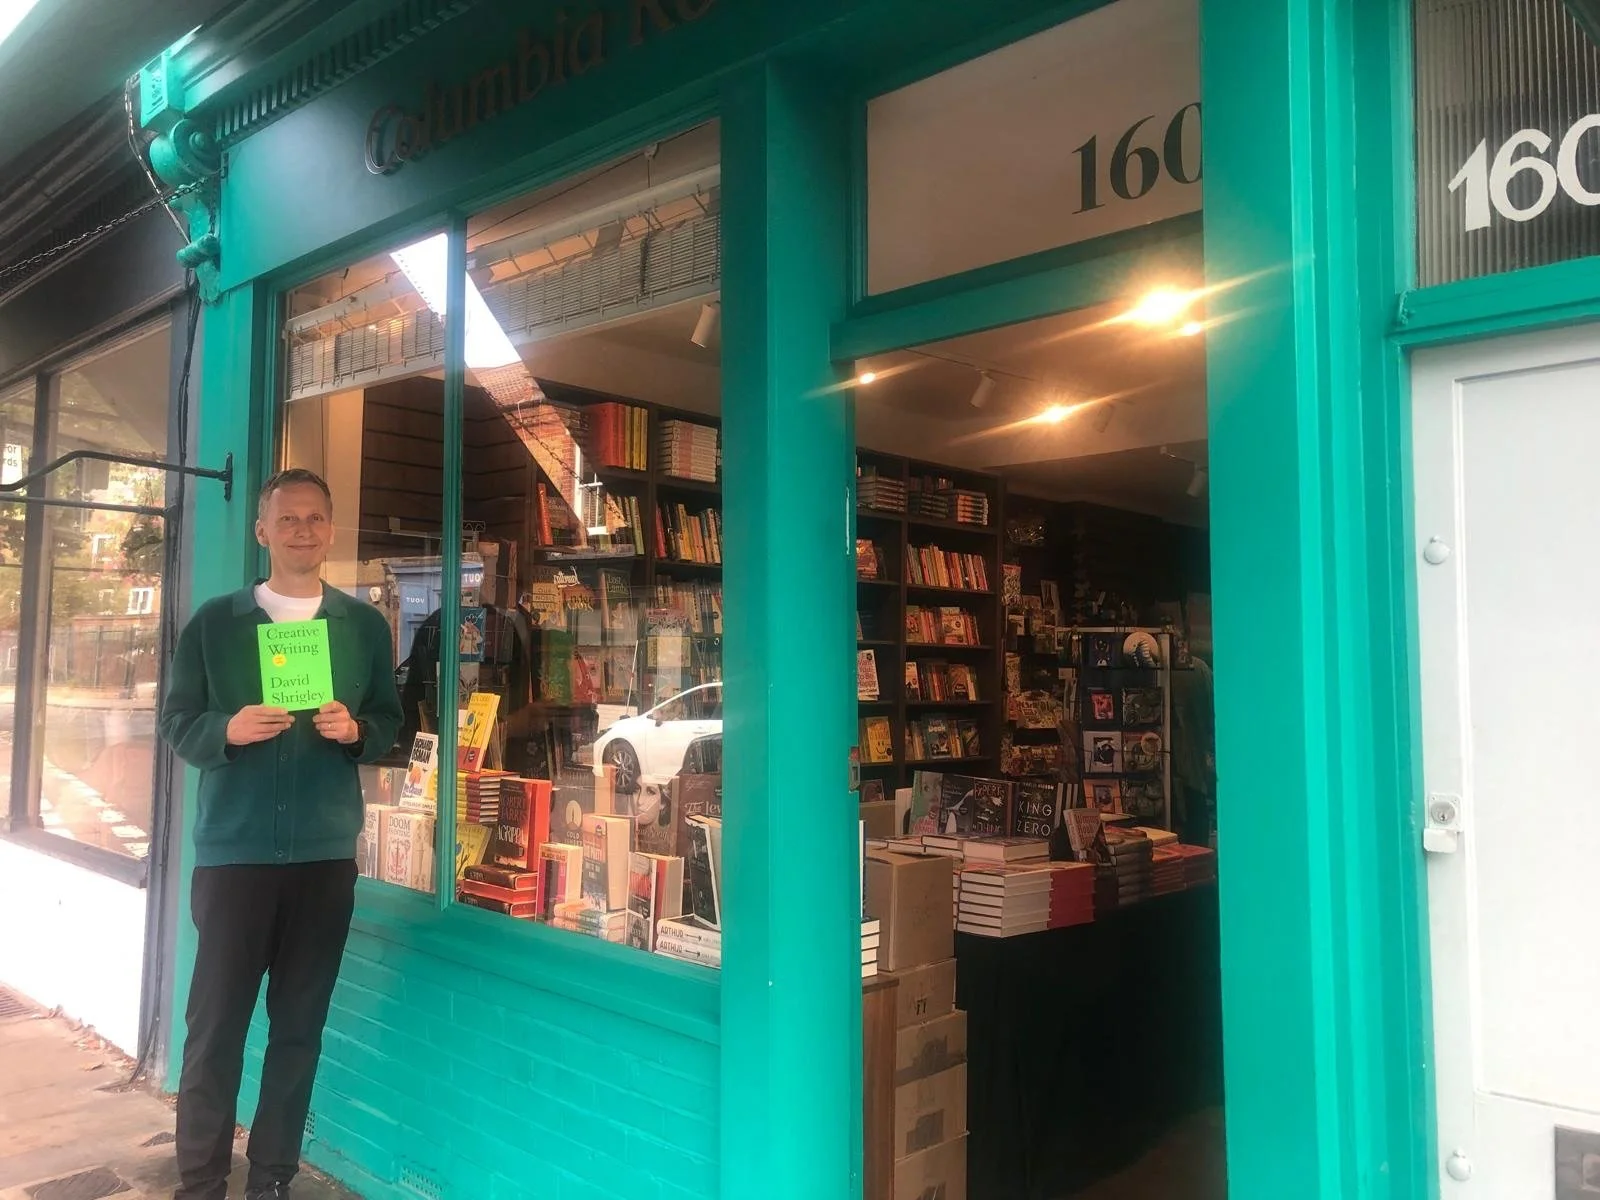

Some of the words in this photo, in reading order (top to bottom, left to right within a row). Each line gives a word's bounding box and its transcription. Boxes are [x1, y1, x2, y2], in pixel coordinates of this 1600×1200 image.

[364, 9, 605, 176] Columbia
[1071, 102, 1203, 215] 160
[1447, 113, 1600, 232] 160
[266, 625, 320, 640] Creative
[267, 642, 319, 656] Writing
[270, 673, 310, 689] David
[271, 689, 325, 706] Shrigley
[1018, 800, 1053, 817] KING
[389, 815, 410, 831] DOOM
[1016, 819, 1051, 837] ZERO
